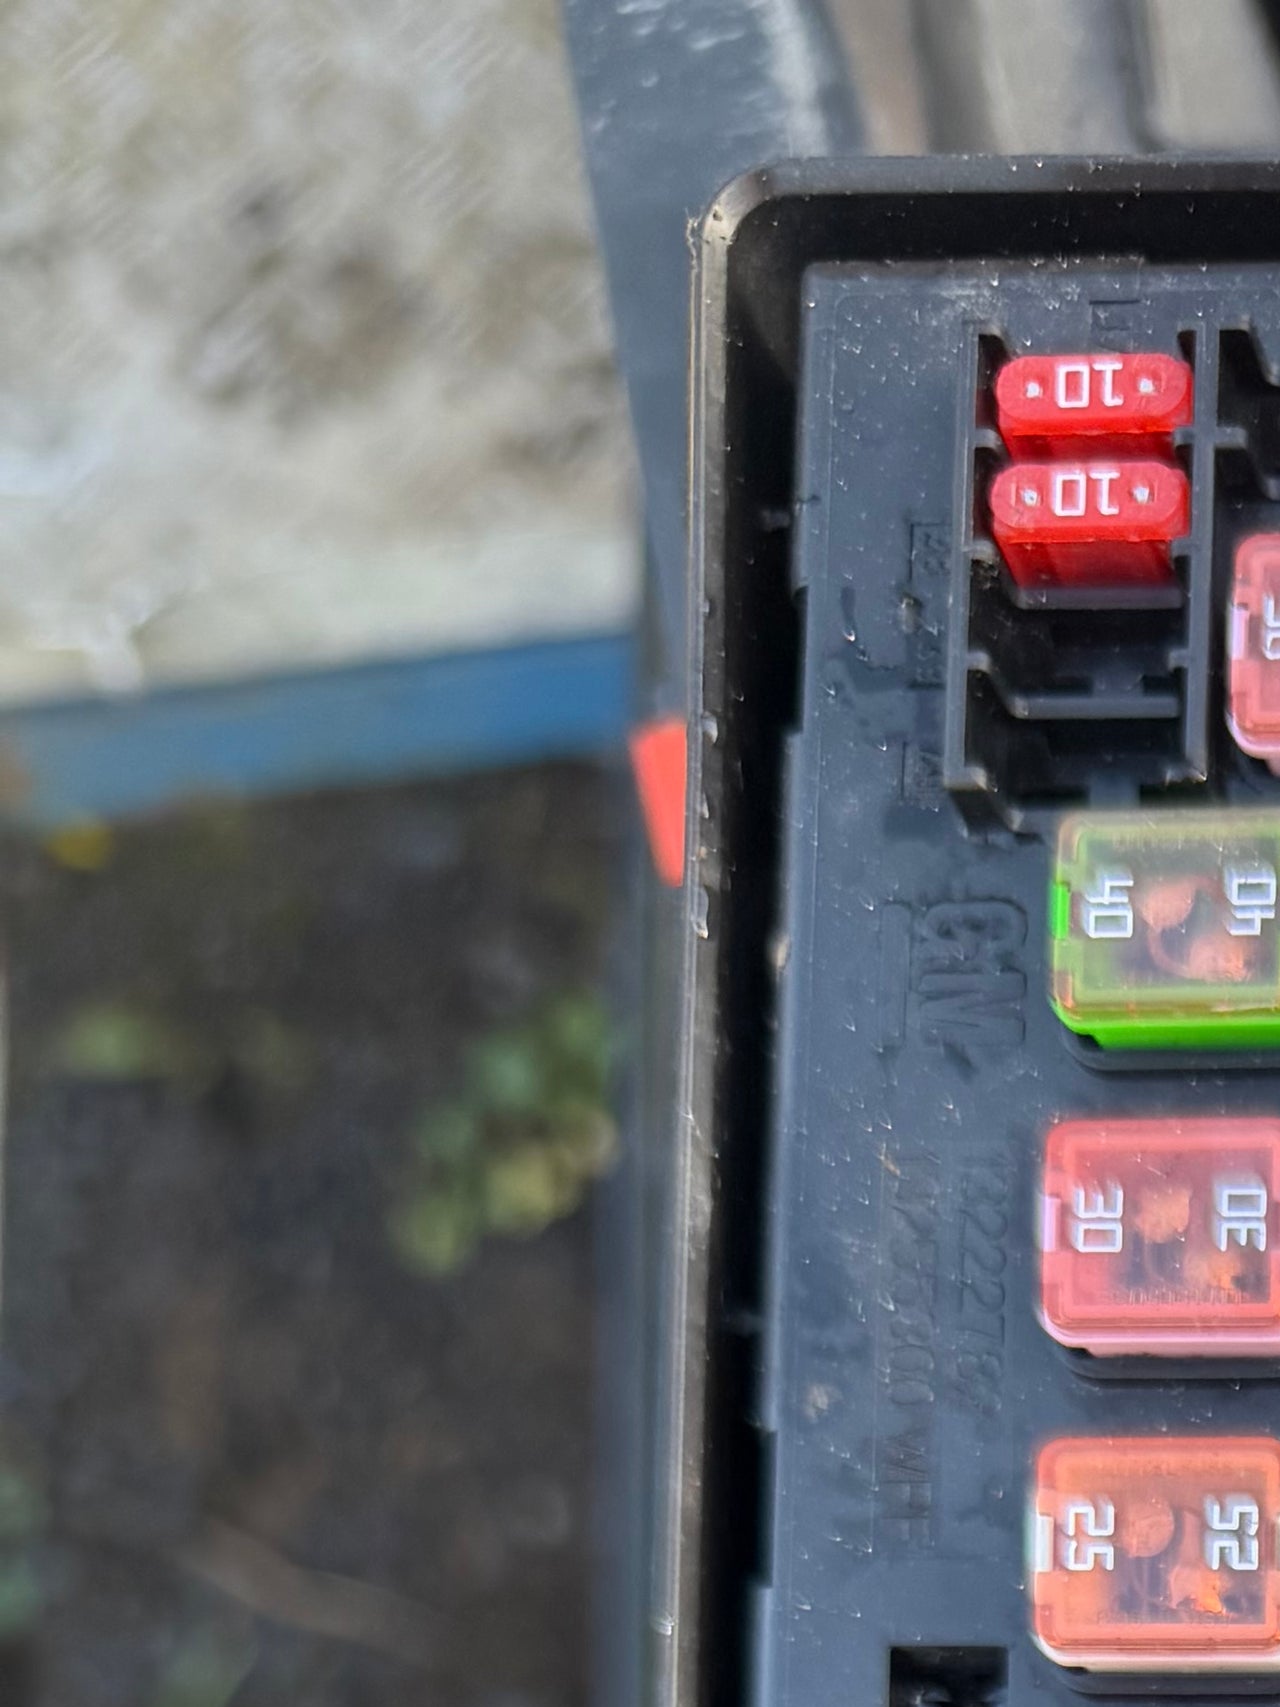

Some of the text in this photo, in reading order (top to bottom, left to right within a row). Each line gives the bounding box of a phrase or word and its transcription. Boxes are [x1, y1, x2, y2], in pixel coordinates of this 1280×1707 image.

[1056, 363, 1124, 407] 10
[1051, 472, 1120, 516] 10
[1084, 870, 1134, 938] 40
[1225, 864, 1277, 936] 40
[1073, 1186, 1123, 1252] 30
[1217, 1185, 1268, 1252] 30
[1067, 1500, 1114, 1570] 25
[1206, 1500, 1259, 1570] 25
